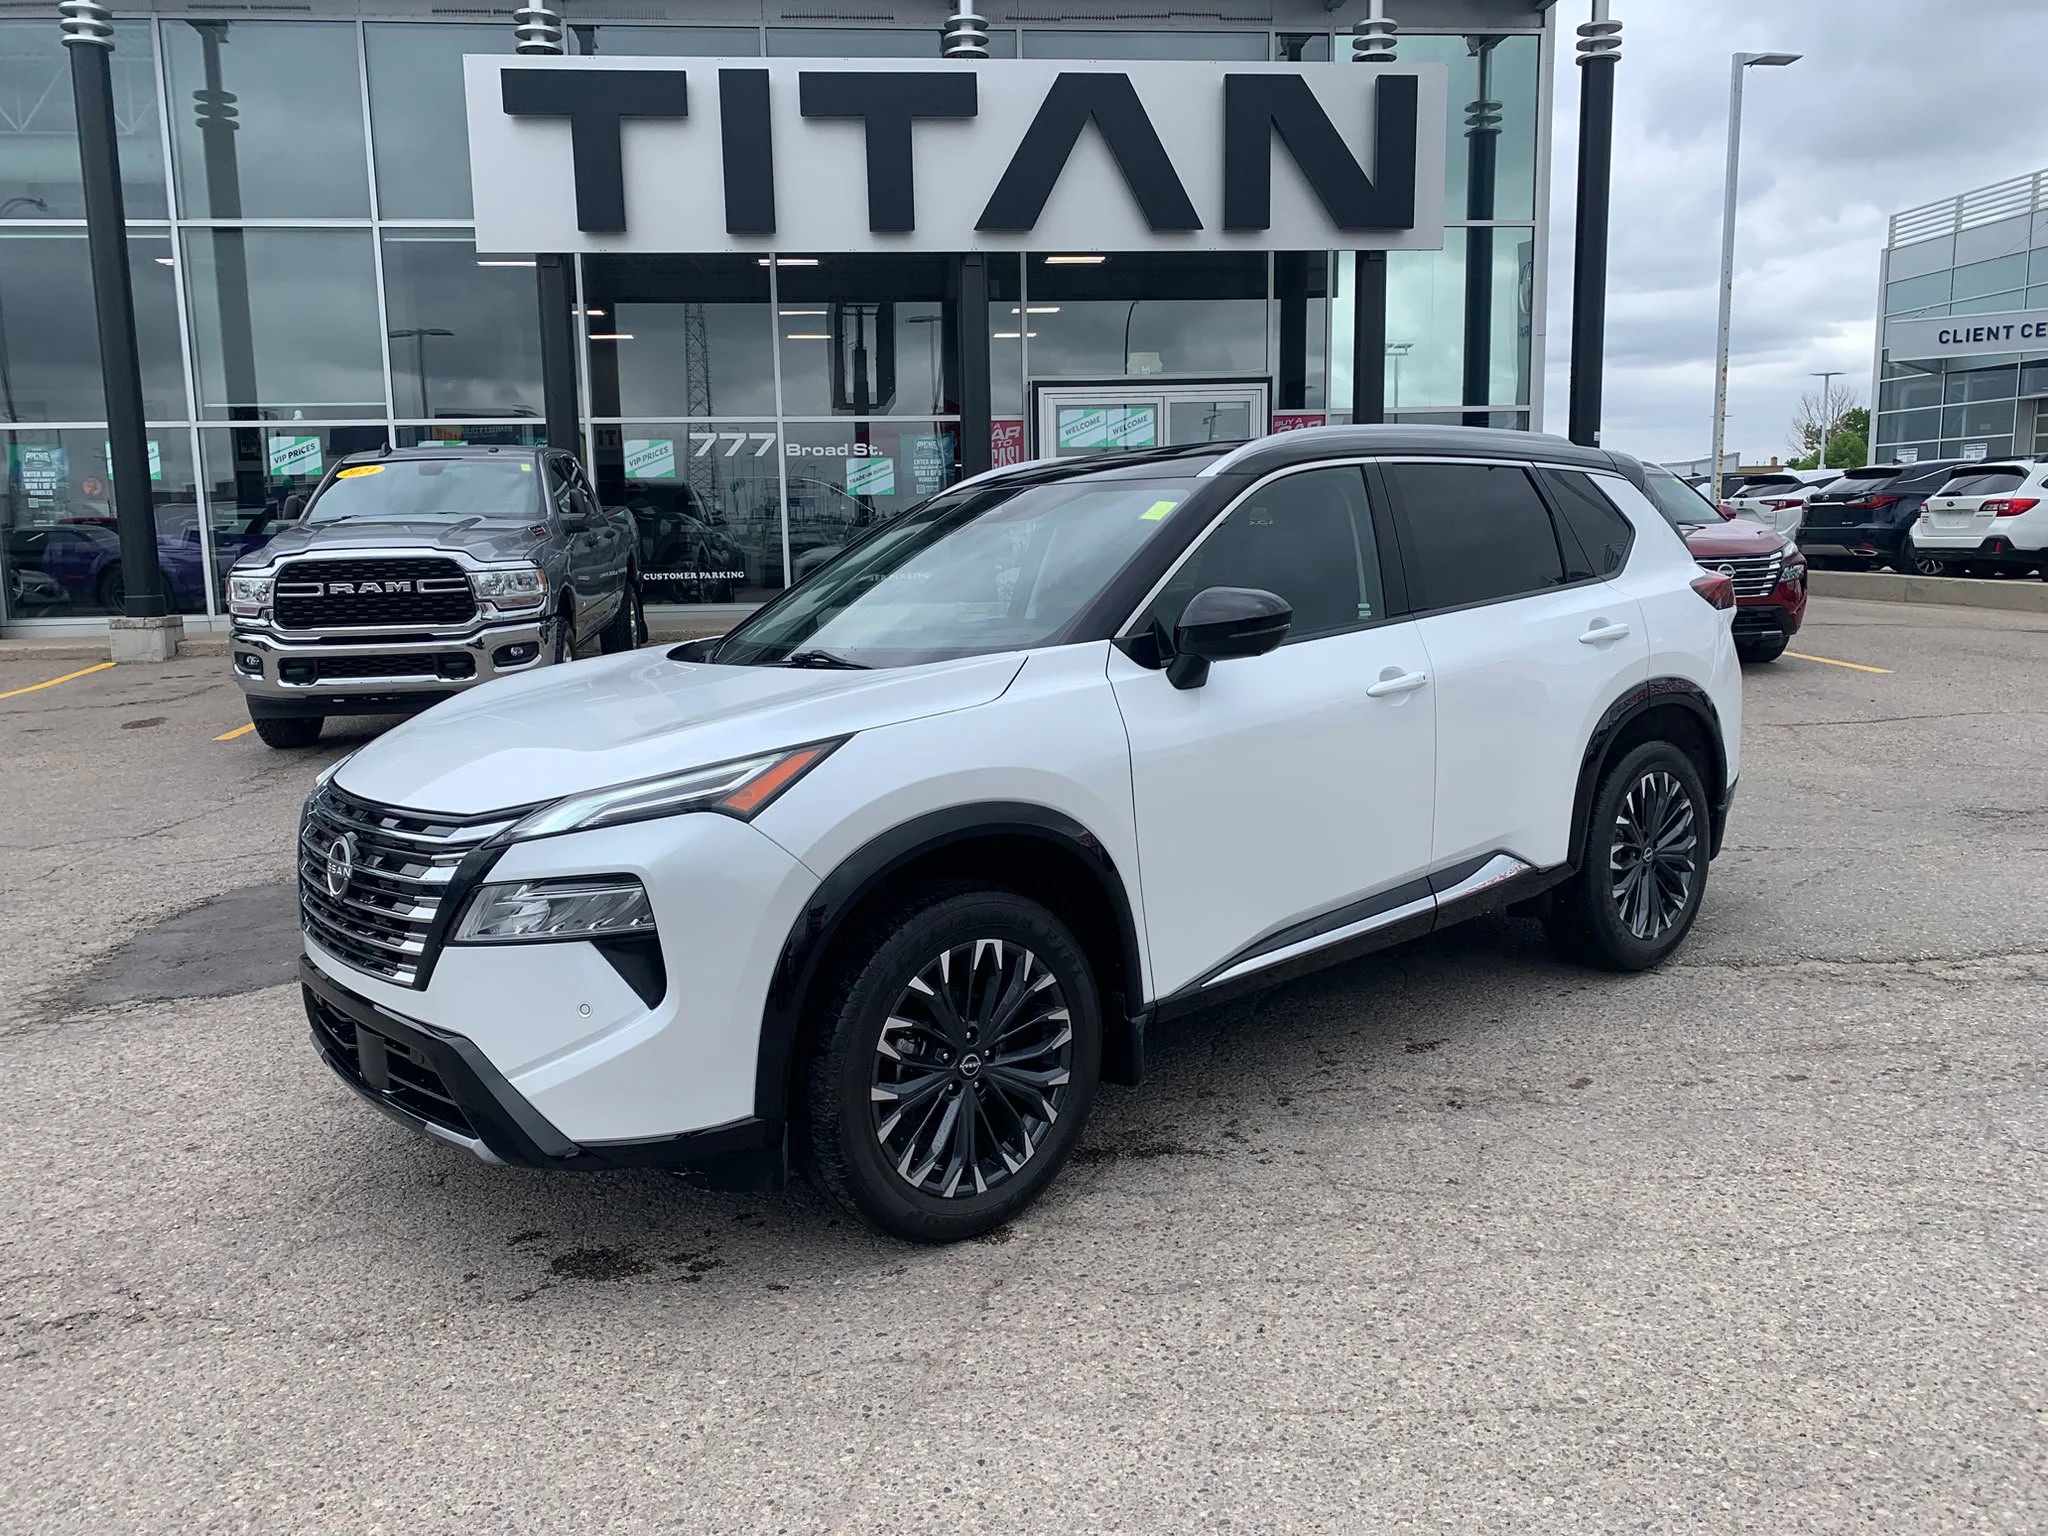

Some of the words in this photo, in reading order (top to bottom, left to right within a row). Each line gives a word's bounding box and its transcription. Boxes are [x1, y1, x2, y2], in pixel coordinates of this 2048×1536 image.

[501, 69, 1419, 236] TITAN
[1938, 324, 2015, 344] CLIENT
[991, 426, 1021, 441] AR
[1064, 415, 1101, 436] WELCOME
[1112, 414, 1148, 435] WELCOME
[273, 453, 288, 464] VIP
[287, 442, 316, 460] PRICES
[689, 432, 777, 457] 777
[785, 443, 849, 457] Broad
[852, 442, 884, 457] St.
[628, 456, 642, 467] VIP
[642, 445, 669, 463] PRICES
[643, 571, 698, 581] CUSTOMER
[699, 571, 745, 580] PARKING
[328, 581, 412, 594] RAM
[327, 862, 351, 877] SSAN
